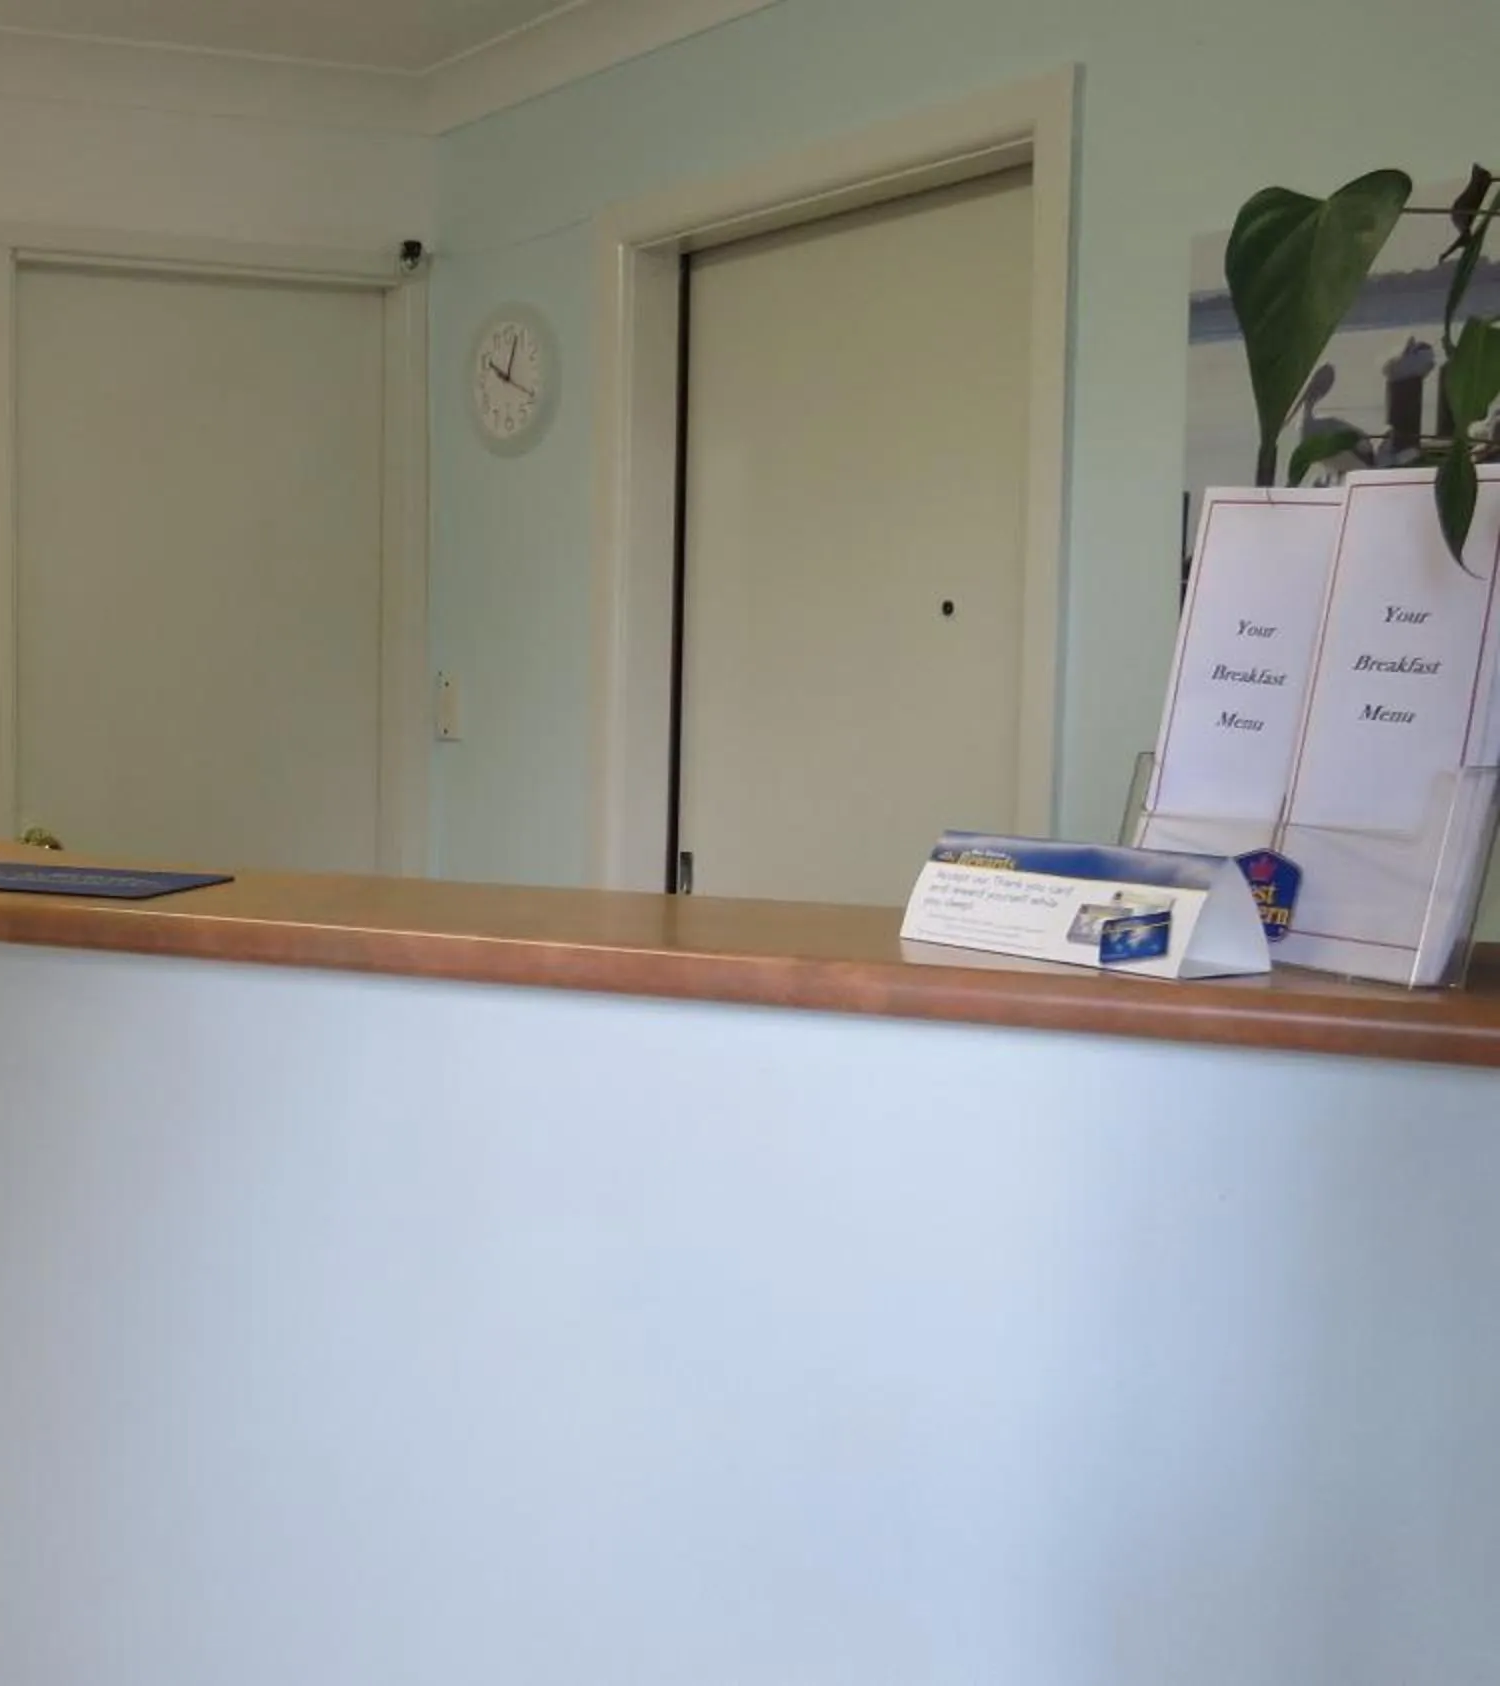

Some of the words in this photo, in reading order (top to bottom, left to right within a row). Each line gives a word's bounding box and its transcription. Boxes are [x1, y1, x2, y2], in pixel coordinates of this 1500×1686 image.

[1382, 605, 1433, 625] Your
[1236, 618, 1277, 638] Your
[1211, 664, 1288, 687] Breakfast
[1353, 654, 1443, 676] Breakfast
[1216, 711, 1266, 732] Menu
[1358, 703, 1417, 724] Menu
[1251, 885, 1277, 905] est
